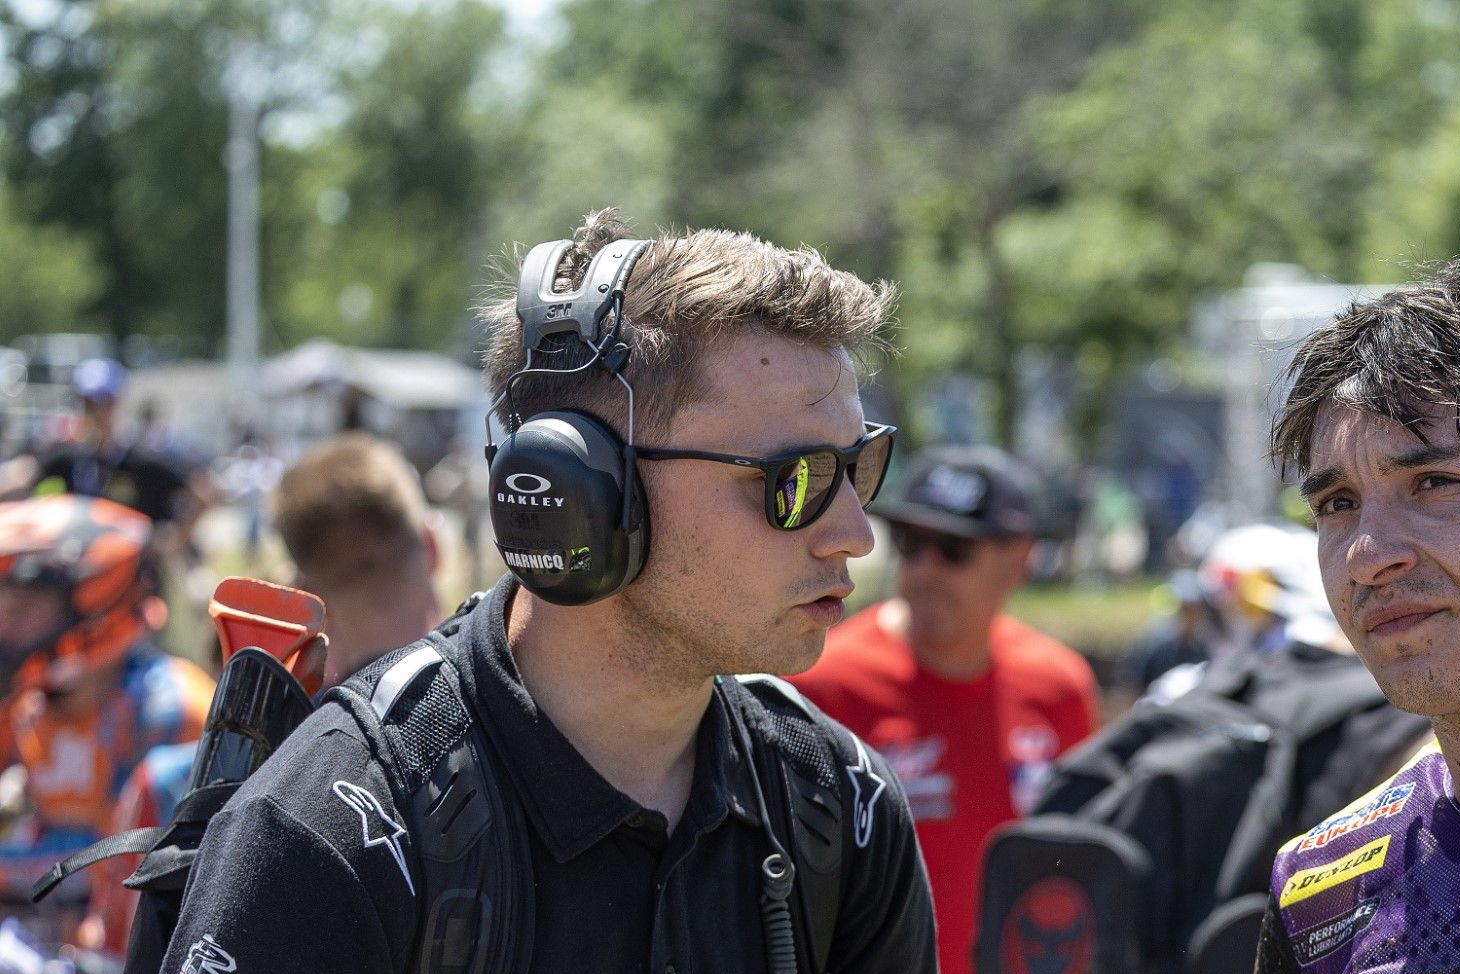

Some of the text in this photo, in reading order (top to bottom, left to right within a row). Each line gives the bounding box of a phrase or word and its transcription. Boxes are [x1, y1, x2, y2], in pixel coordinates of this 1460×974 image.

[546, 302, 573, 319] 3M
[497, 493, 564, 507] OAKLEY
[504, 551, 564, 570] MARNICQ
[1301, 800, 1405, 850] EUROPE
[1299, 845, 1384, 890] DUNLOP
[1308, 901, 1375, 944] PERFORMANCE
